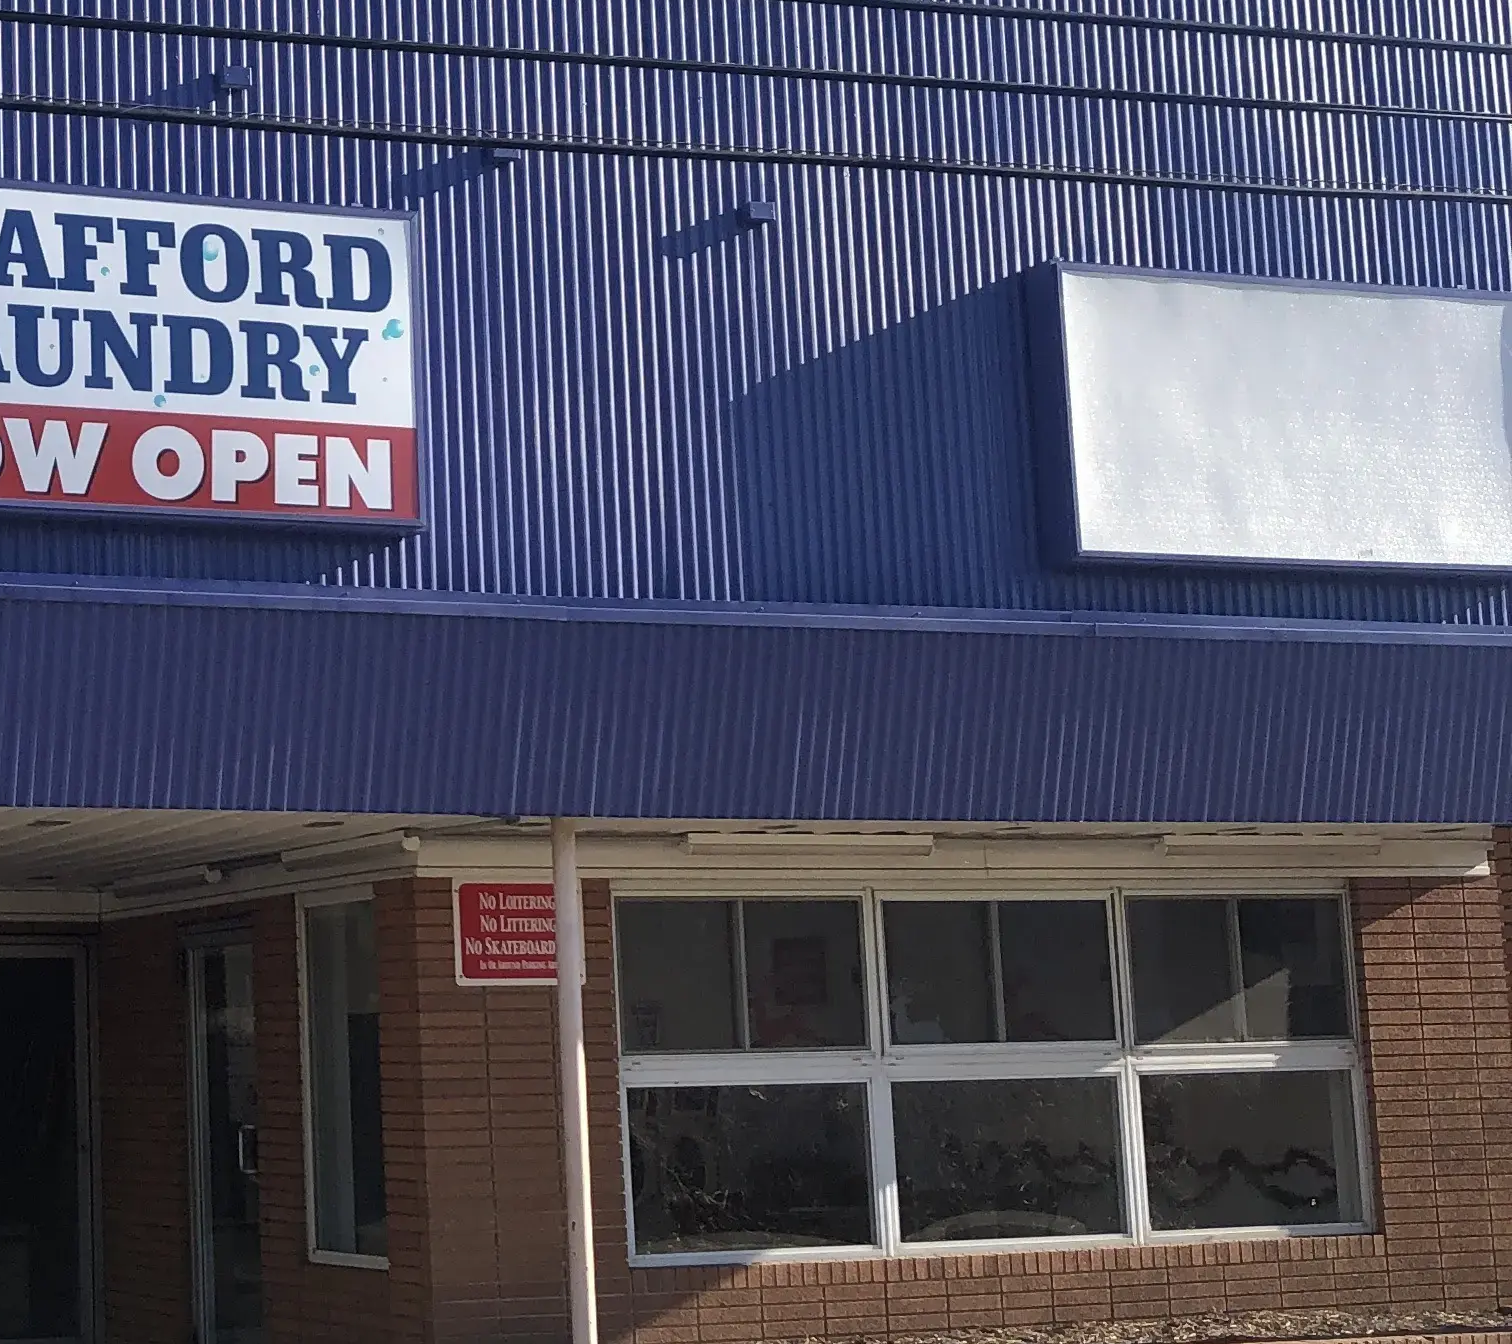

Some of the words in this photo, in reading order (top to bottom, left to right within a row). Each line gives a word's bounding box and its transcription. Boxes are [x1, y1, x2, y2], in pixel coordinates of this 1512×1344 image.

[132, 424, 393, 511] OPEN
[478, 892, 497, 910] NO
[498, 892, 556, 910] LOITERING
[479, 914, 498, 932] NO
[499, 914, 556, 932] LITTERING
[465, 936, 483, 955] NO
[484, 936, 556, 955] SKATEBOARD
